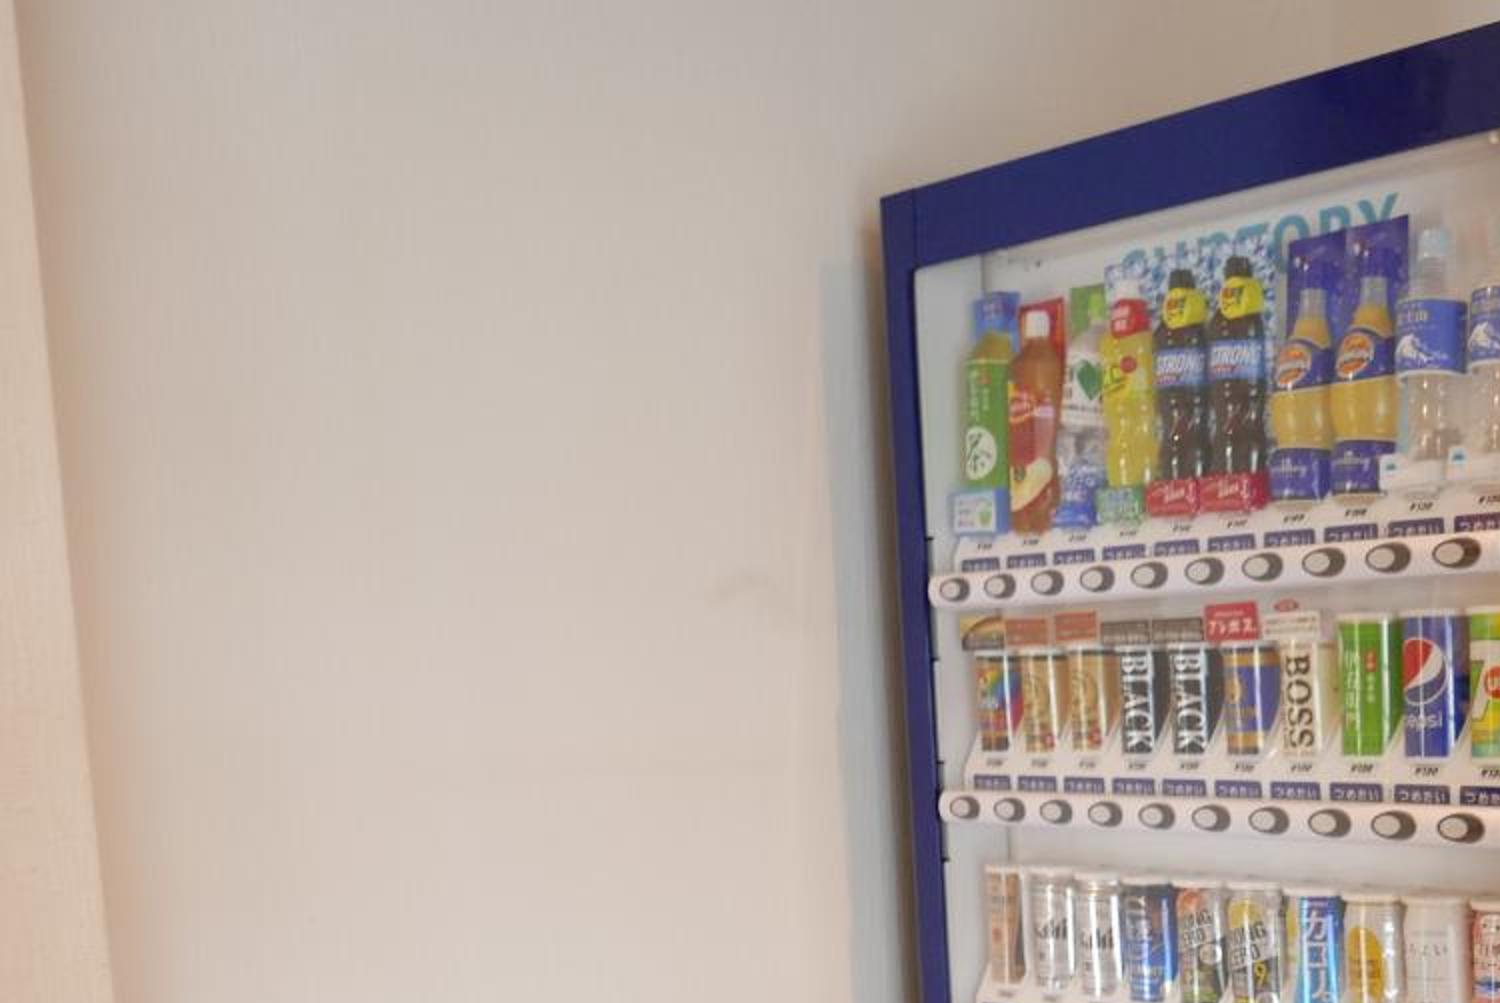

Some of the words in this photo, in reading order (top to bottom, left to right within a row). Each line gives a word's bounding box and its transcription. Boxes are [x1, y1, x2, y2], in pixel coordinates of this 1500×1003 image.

[1121, 646, 1153, 753] BLACK
[1173, 645, 1207, 754] BLACK
[1285, 655, 1315, 748] BOSS
